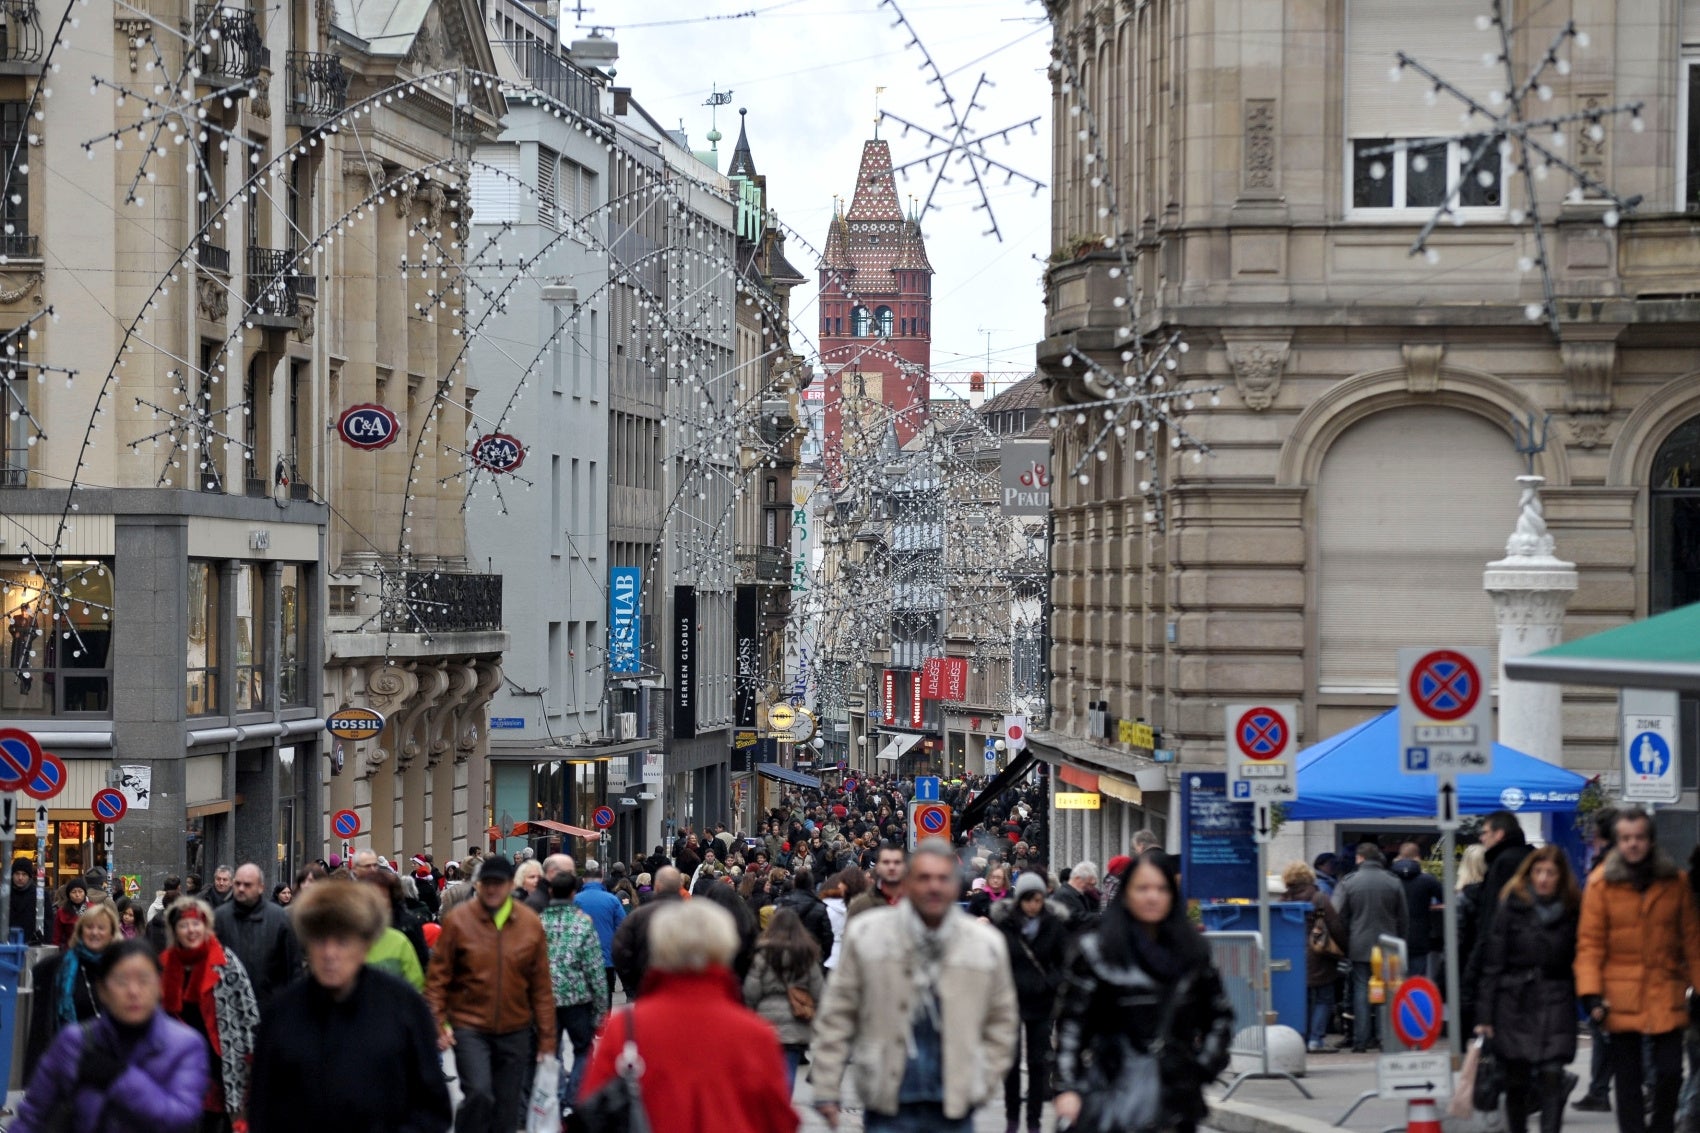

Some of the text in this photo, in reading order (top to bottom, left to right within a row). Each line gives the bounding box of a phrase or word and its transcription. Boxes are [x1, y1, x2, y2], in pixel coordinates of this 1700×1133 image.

[349, 416, 387, 436] C&A
[482, 443, 514, 462] C&A
[793, 510, 808, 591] REX
[681, 617, 689, 707] HERREN GLOBUS
[739, 637, 750, 676] BOSS
[929, 660, 940, 696] ESPRIT
[949, 661, 961, 698] ESPRIT
[331, 719, 378, 729] FOSSIL
[1411, 750, 1426, 768] P
[1236, 783, 1248, 797] P
